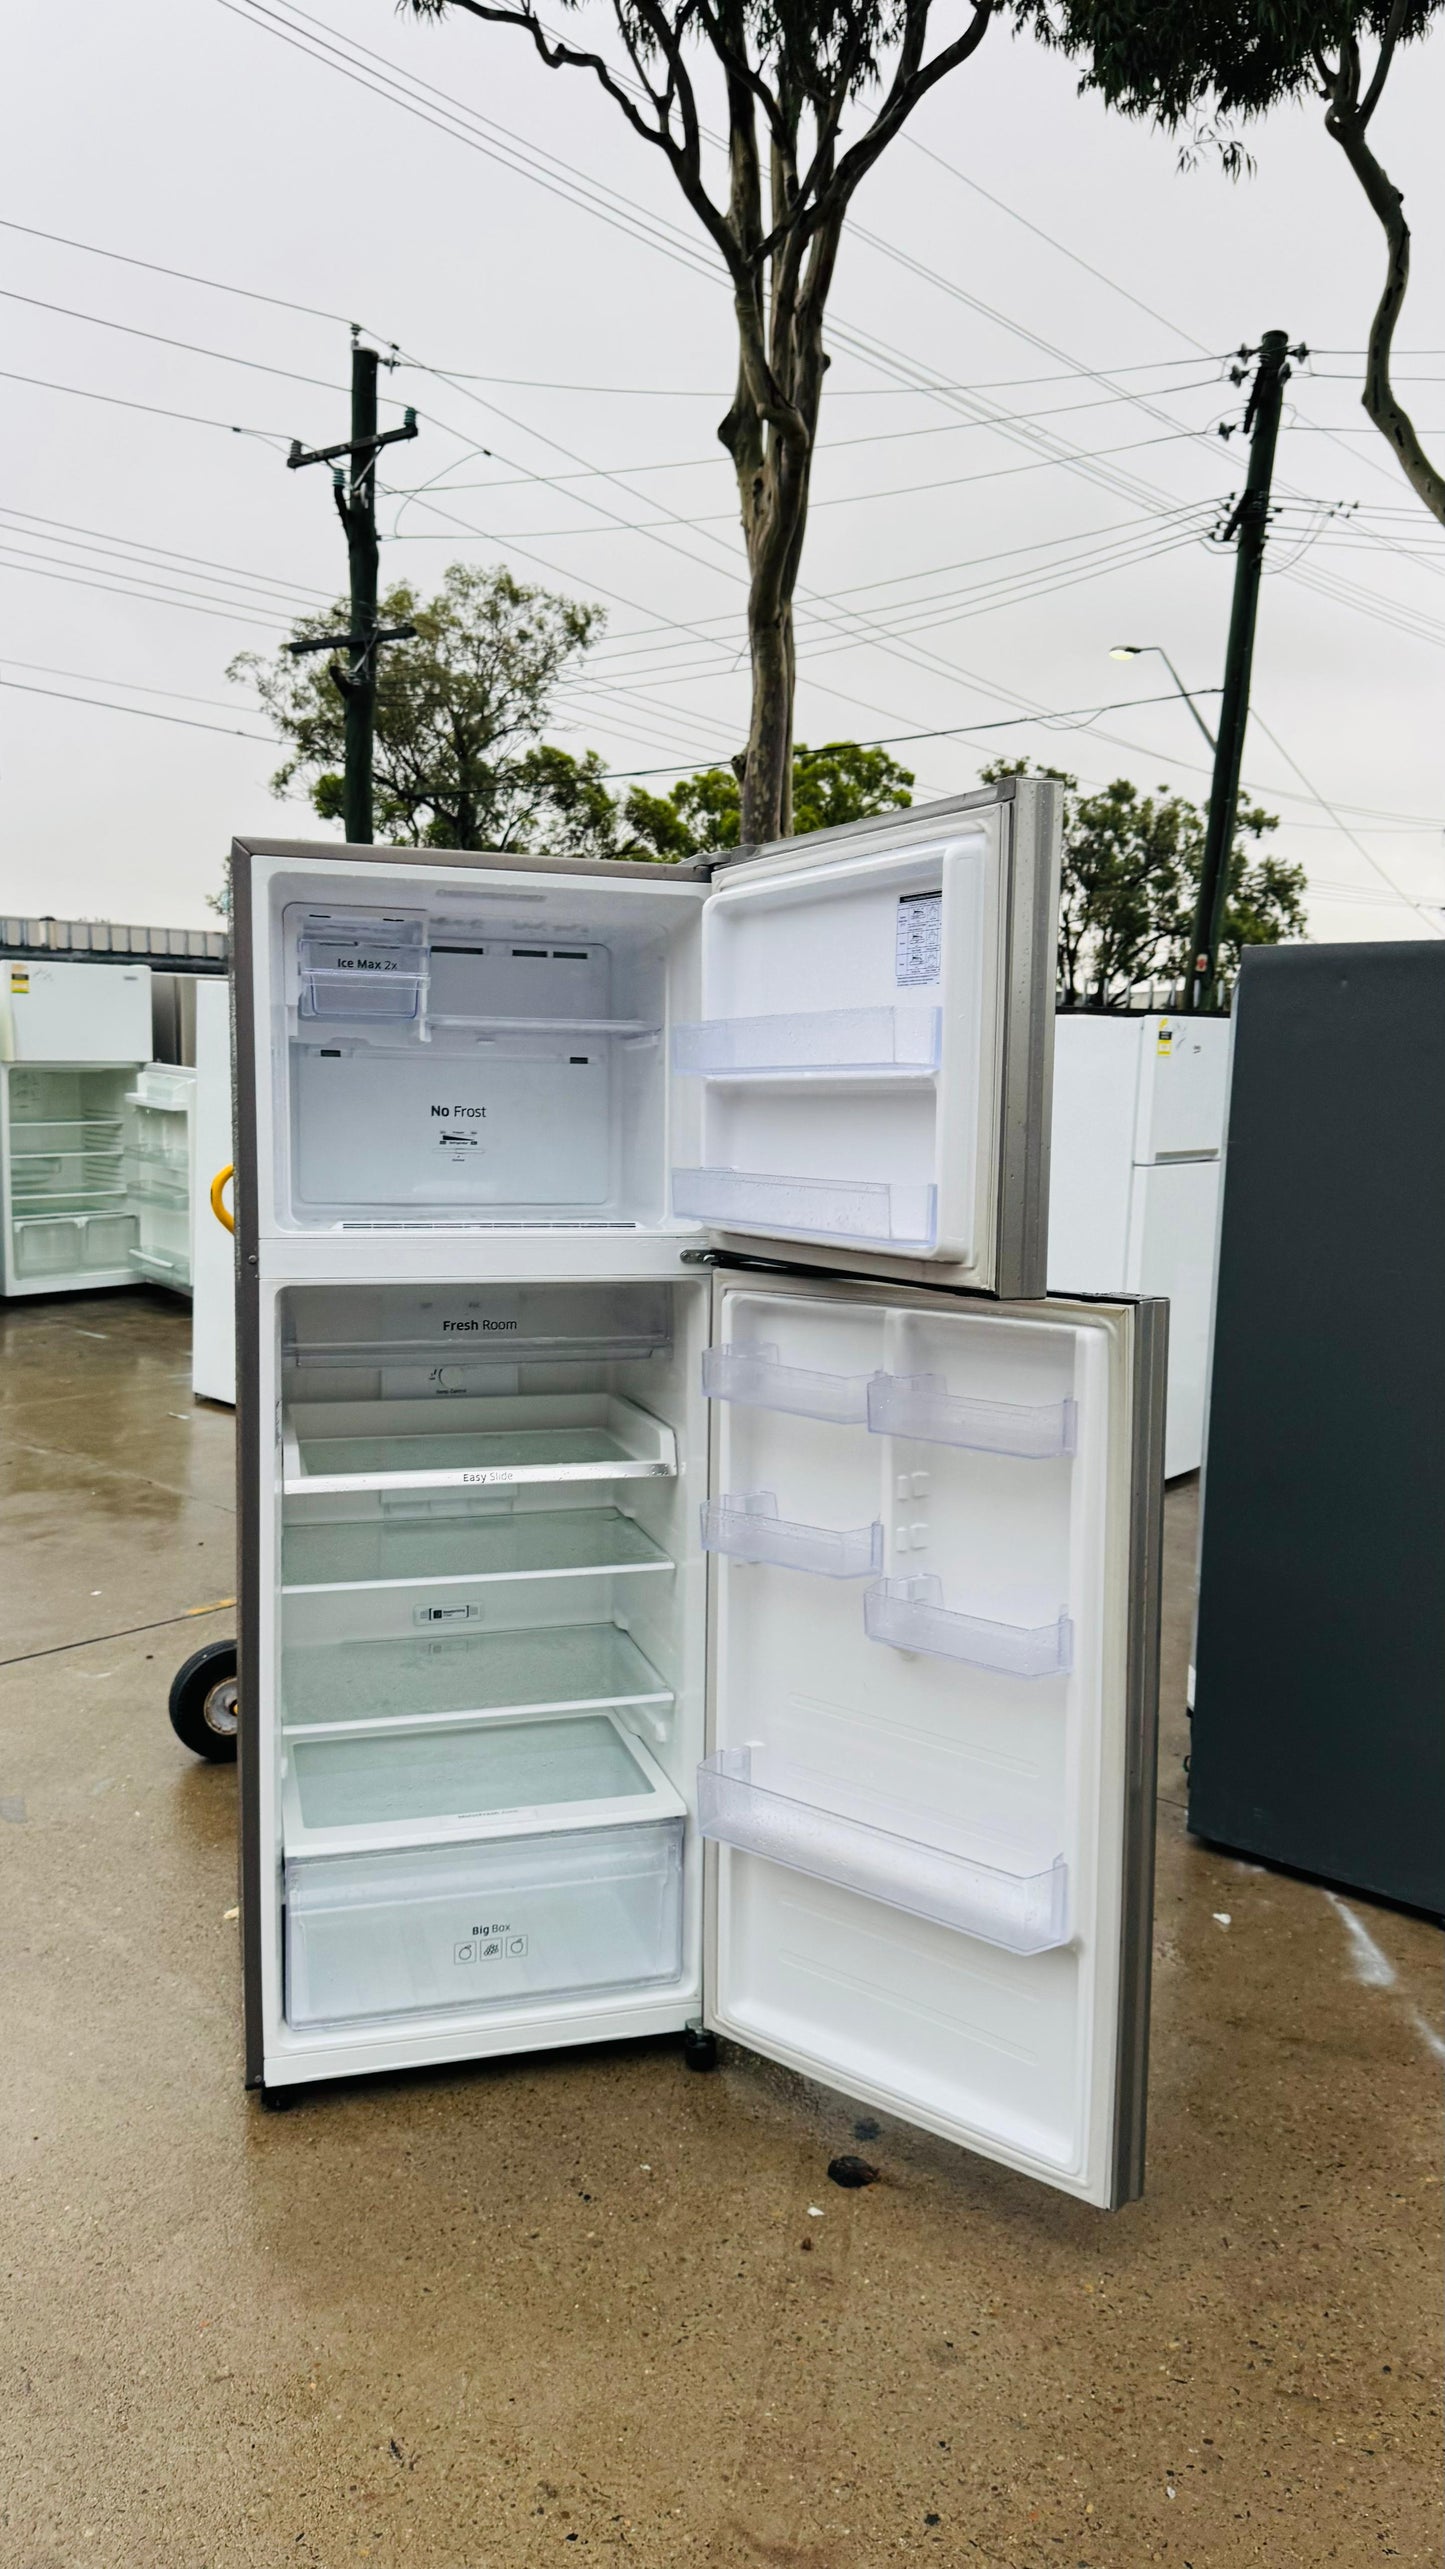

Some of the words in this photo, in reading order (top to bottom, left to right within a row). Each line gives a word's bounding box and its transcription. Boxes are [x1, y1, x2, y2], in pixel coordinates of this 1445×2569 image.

[337, 958, 354, 968] Ice
[357, 959, 381, 970] Max
[384, 960, 398, 970] 2x
[431, 1105, 450, 1117] No
[454, 1105, 487, 1118] Frost
[443, 1320, 479, 1331] Fresh
[482, 1319, 518, 1330] Room
[463, 1473, 487, 1484] Easy
[489, 1471, 513, 1481] Slide
[472, 1925, 490, 1937] Big
[491, 1923, 511, 1934] Box
